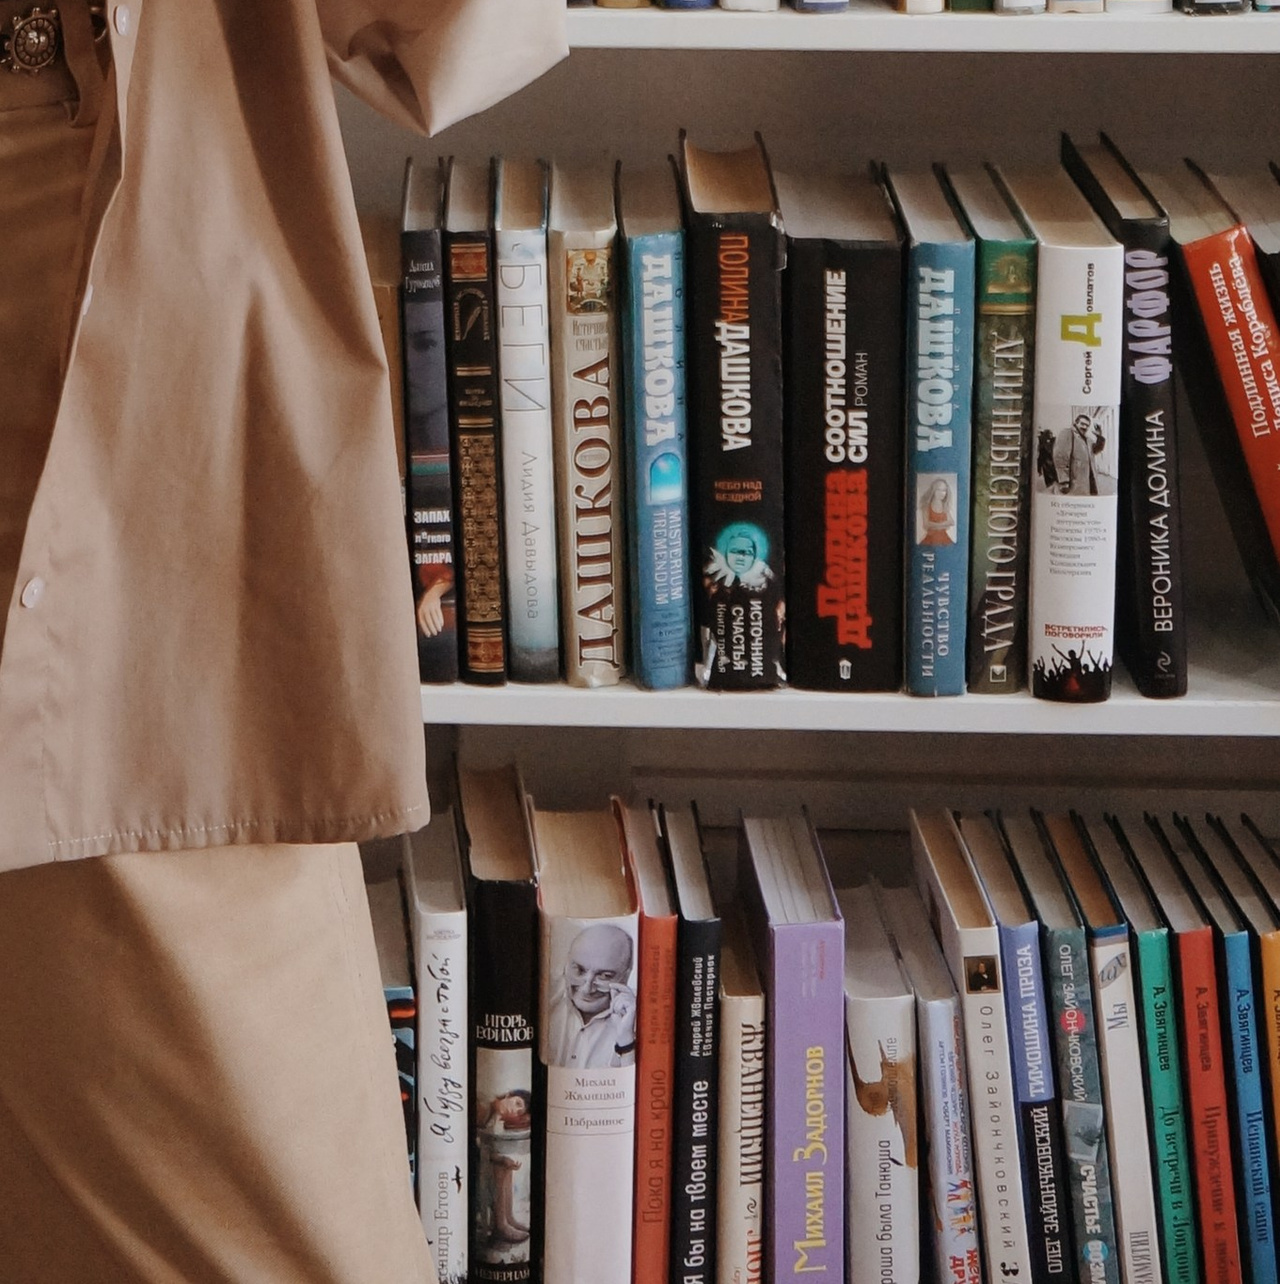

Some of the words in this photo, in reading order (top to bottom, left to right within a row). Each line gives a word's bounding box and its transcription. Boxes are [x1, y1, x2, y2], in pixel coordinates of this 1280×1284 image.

[720, 235, 749, 321] ПОЛИНА
[1125, 249, 1173, 385] ФАРФОР
[499, 263, 547, 413] БЕГИ
[641, 255, 676, 448] ДАШКОВА
[825, 269, 847, 463] СООТНОШЕНИЕ
[855, 352, 869, 408] РОМАН
[917, 269, 955, 451] ДАШКОВА
[714, 321, 753, 452] ДАШКОВА
[846, 410, 869, 464] СИЛ
[1144, 409, 1171, 508] ДОЛИНА
[413, 510, 450, 524] ЗАПАХ
[572, 354, 618, 668] ДАШКОВА
[414, 552, 452, 566] ЗАГАРА
[654, 510, 669, 605] TREMENDUM
[668, 510, 683, 602] MISTERIUM
[1149, 514, 1173, 632] ВЕРОНИКА
[732, 606, 745, 672] СЧАСТЬЯ
[750, 600, 764, 677] ИСТОЧНИК
[922, 551, 936, 678] РЕАЛЬНОСТИ
[691, 956, 703, 1018] Жвалевский
[1017, 946, 1035, 998] ПРОЗА
[1059, 945, 1073, 979] ОЛЕГ
[477, 1026, 534, 1042] ЕФИМОВ
[485, 1014, 526, 1028] ИГОРЬ
[689, 1021, 702, 1057] Андрей
[979, 1006, 994, 1057] Олег
[1022, 1003, 1045, 1097] ТИМОШИНА
[1061, 984, 1086, 1102] ЗАЙОНЧКОВСКИЙ
[1106, 1003, 1129, 1030] Мы
[985, 1072, 1015, 1249] Зайончковский
[1031, 1105, 1060, 1232] ЗАЙОНЧКОВСКИЙ
[1246, 1110, 1267, 1198] Испанский
[1047, 1237, 1063, 1273] ОЛЕГ
